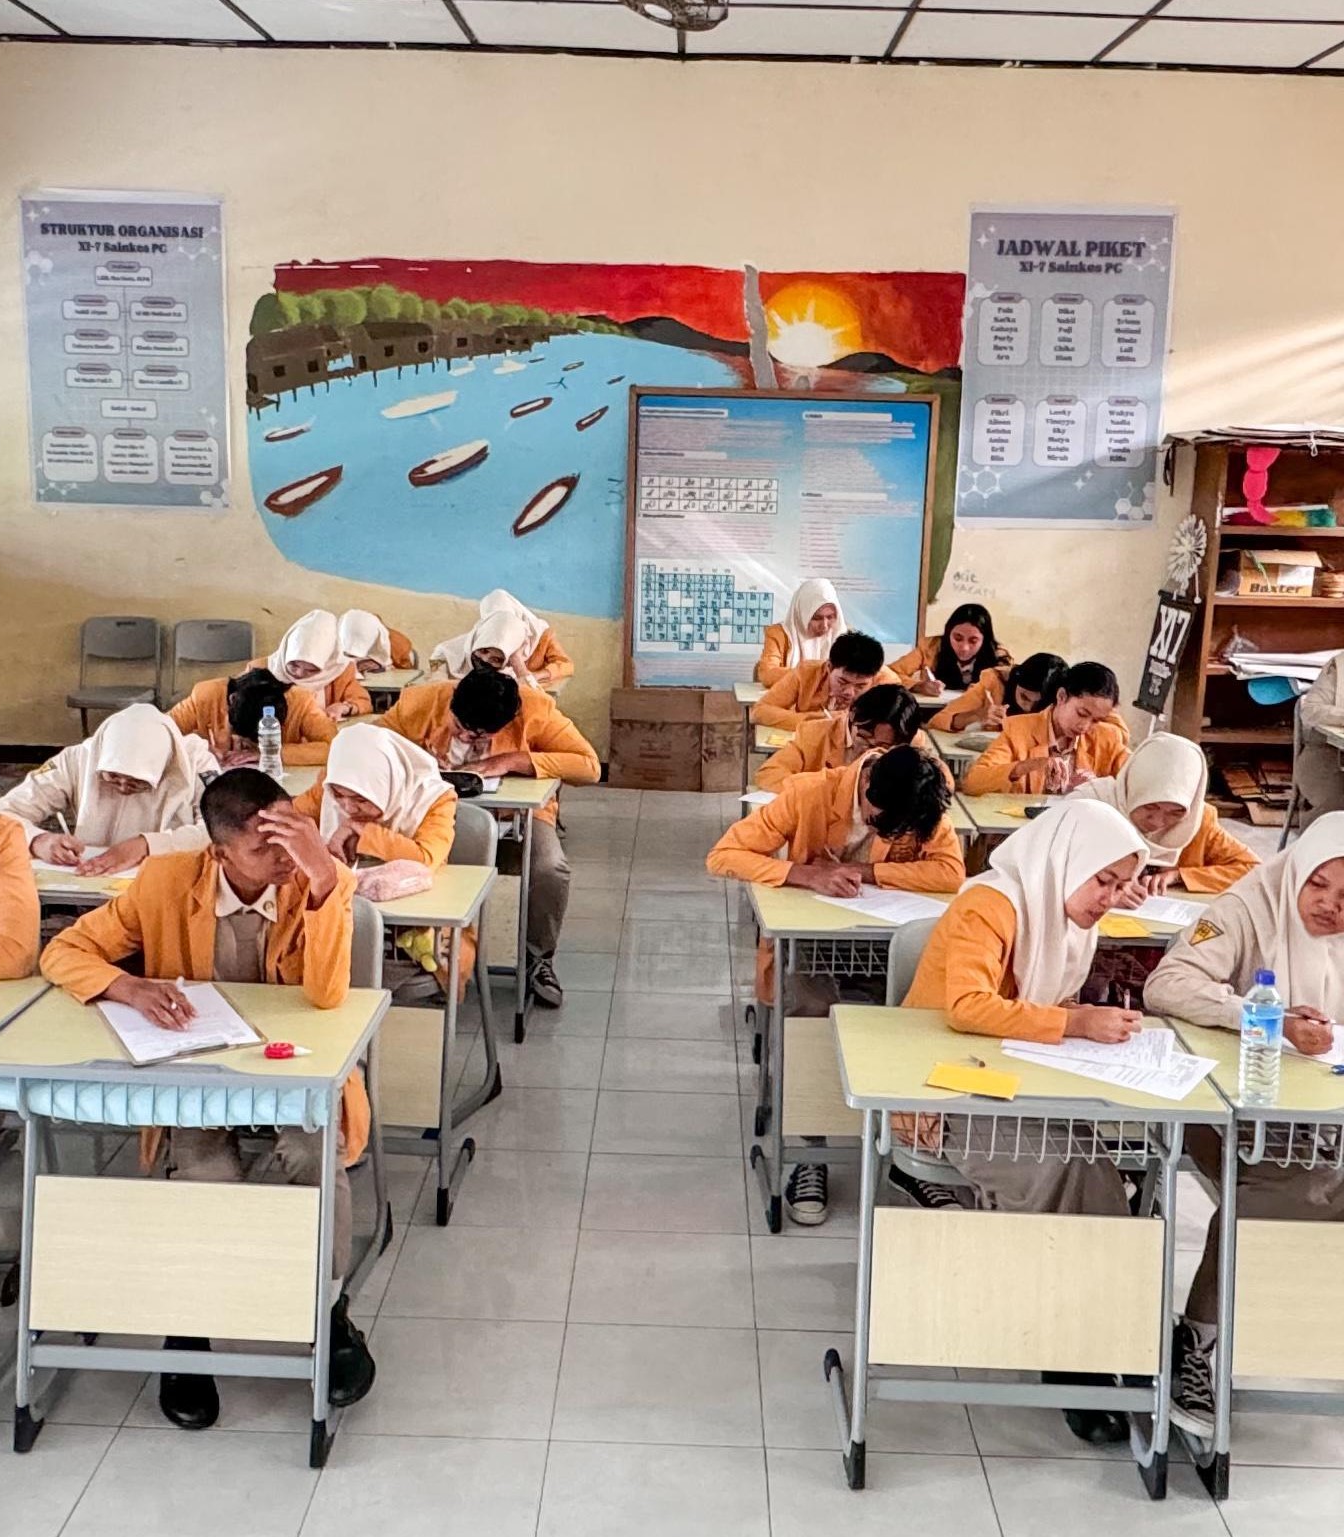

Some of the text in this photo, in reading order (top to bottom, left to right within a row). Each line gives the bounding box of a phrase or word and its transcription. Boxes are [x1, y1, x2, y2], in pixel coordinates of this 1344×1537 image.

[40, 223, 204, 239] STRUKTUR ORGANISASI
[78, 241, 101, 252] XI-7
[152, 243, 168, 254] PC
[996, 239, 1147, 258] JADWAL PIKET
[1019, 260, 1123, 274] XI-7 Sainkes PC
[1249, 582, 1304, 594] Baxter
